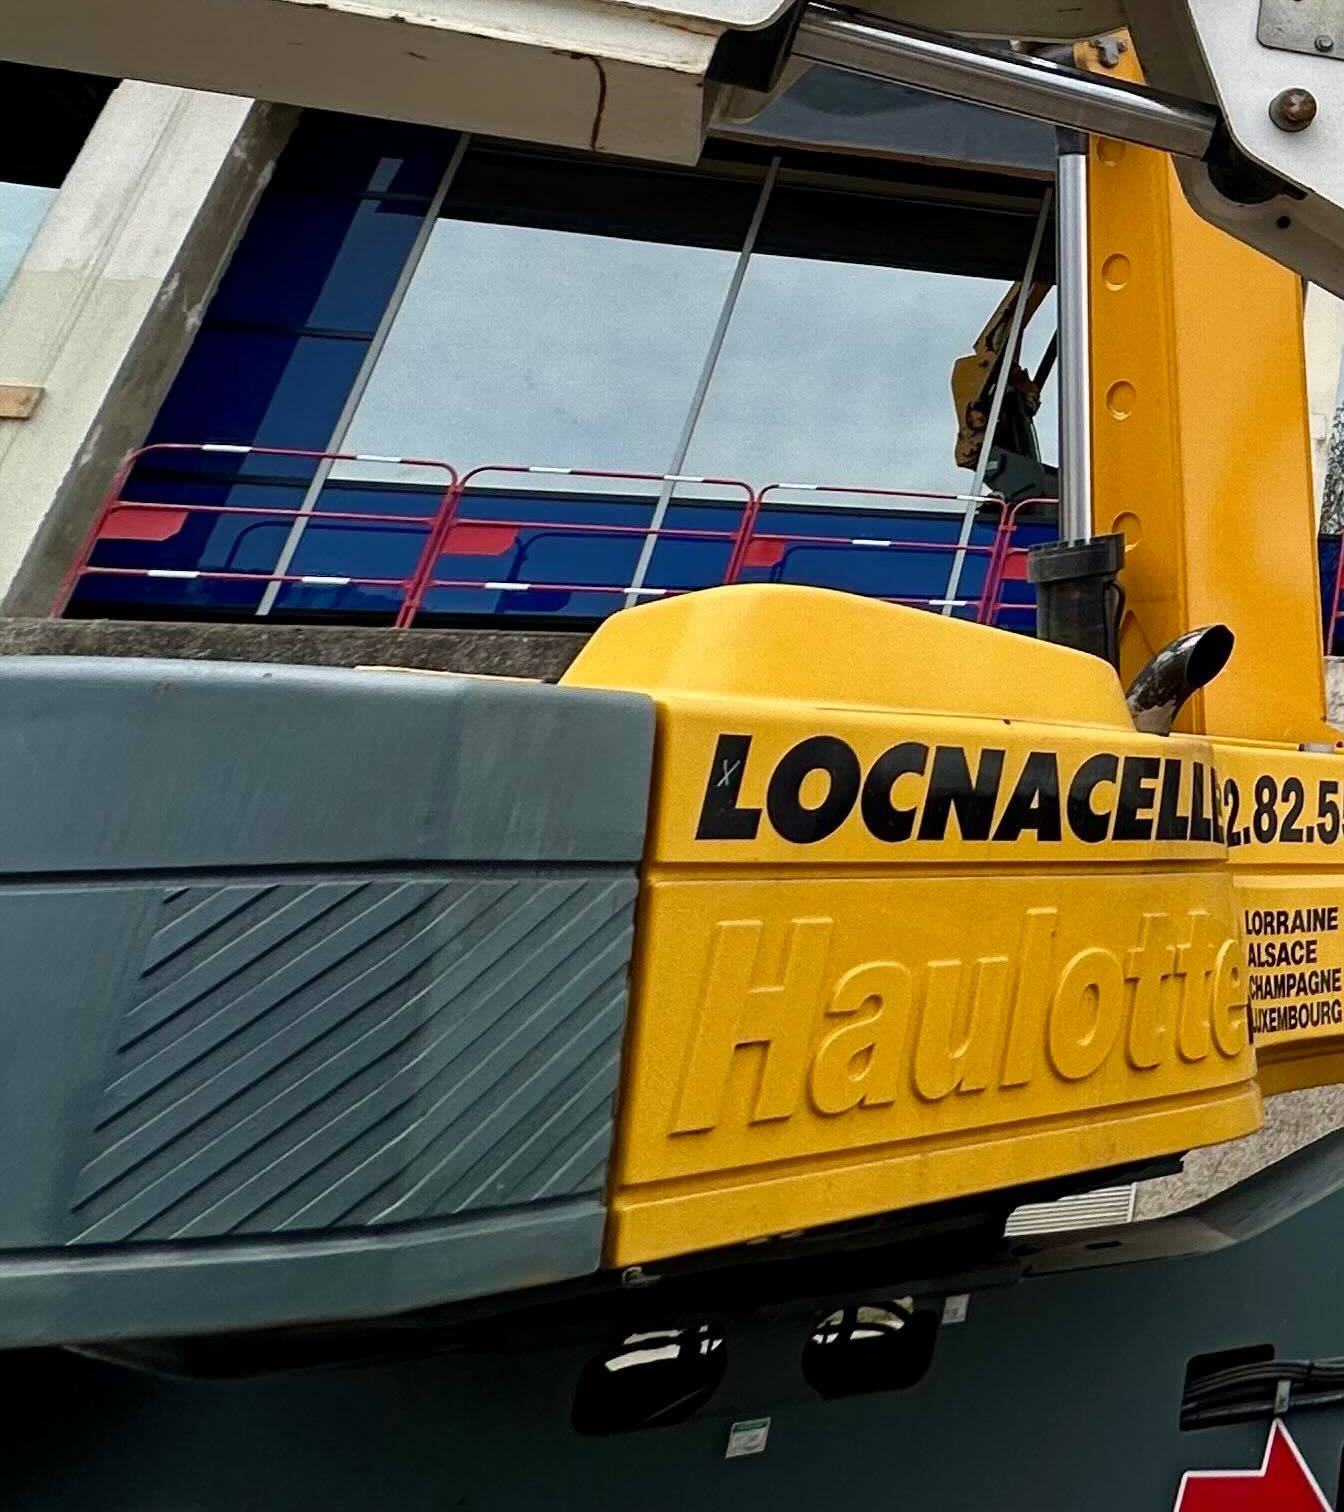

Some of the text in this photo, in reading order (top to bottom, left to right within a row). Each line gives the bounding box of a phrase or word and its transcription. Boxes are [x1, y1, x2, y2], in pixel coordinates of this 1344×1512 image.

[1244, 906, 1340, 936] LORRAINE
[1247, 939, 1318, 968] ALSACE
[1249, 967, 1342, 1001] CHAMPAGNE
[669, 906, 1249, 1136] Haulotte
